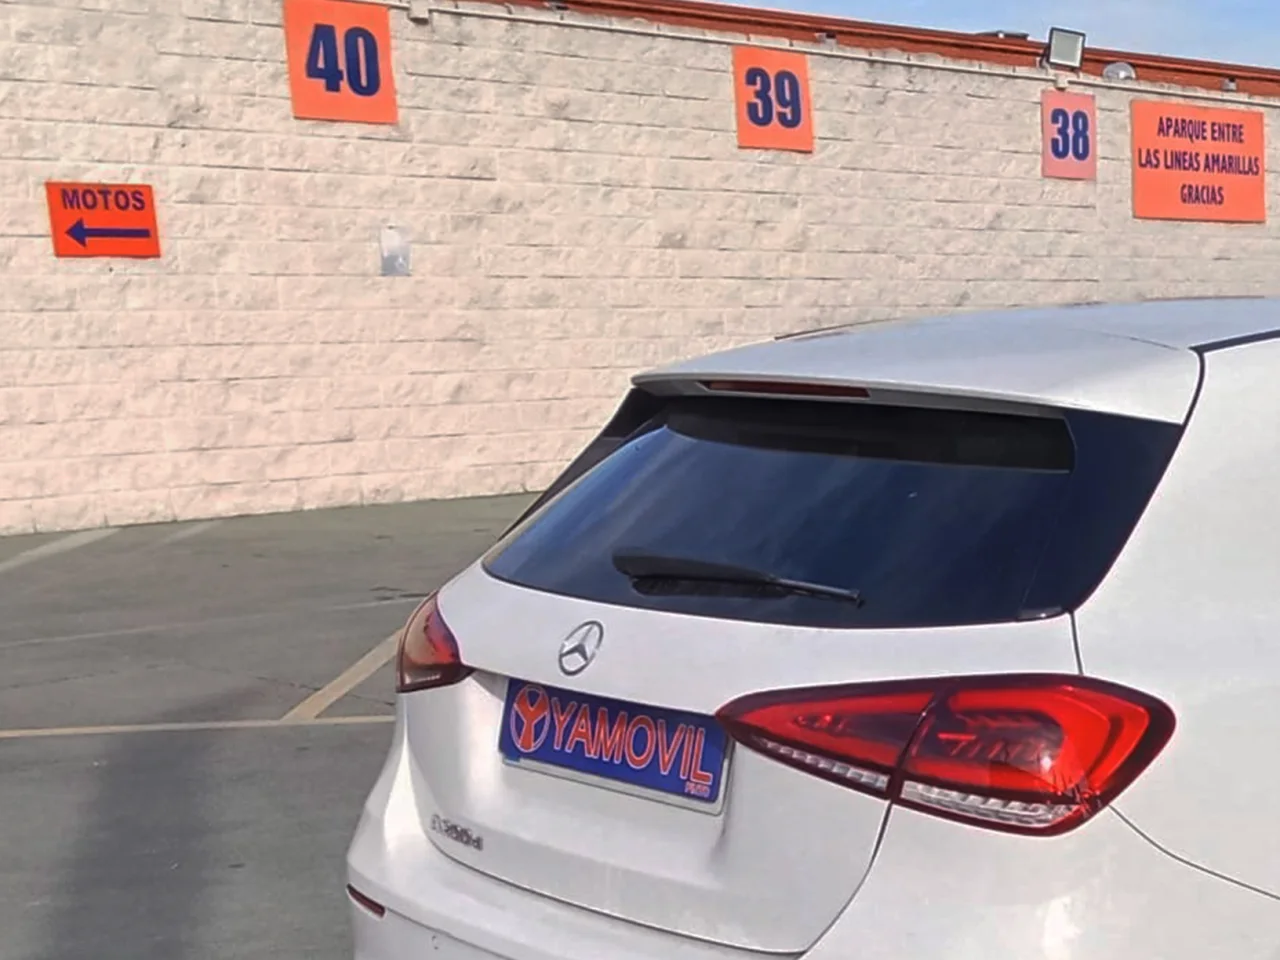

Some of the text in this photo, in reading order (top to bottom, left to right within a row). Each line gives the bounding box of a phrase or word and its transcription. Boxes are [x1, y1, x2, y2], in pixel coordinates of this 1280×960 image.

[306, 24, 380, 96] 40
[746, 67, 801, 128] 39
[1050, 108, 1090, 161] 38
[1157, 116, 1244, 144] APARQUE ENTRE
[1138, 148, 1260, 177] LAS LINEAS AMARILLAS
[61, 188, 146, 212] MOTOS
[1180, 183, 1225, 206] GRACIAS
[549, 696, 713, 786] YAMOVIL
